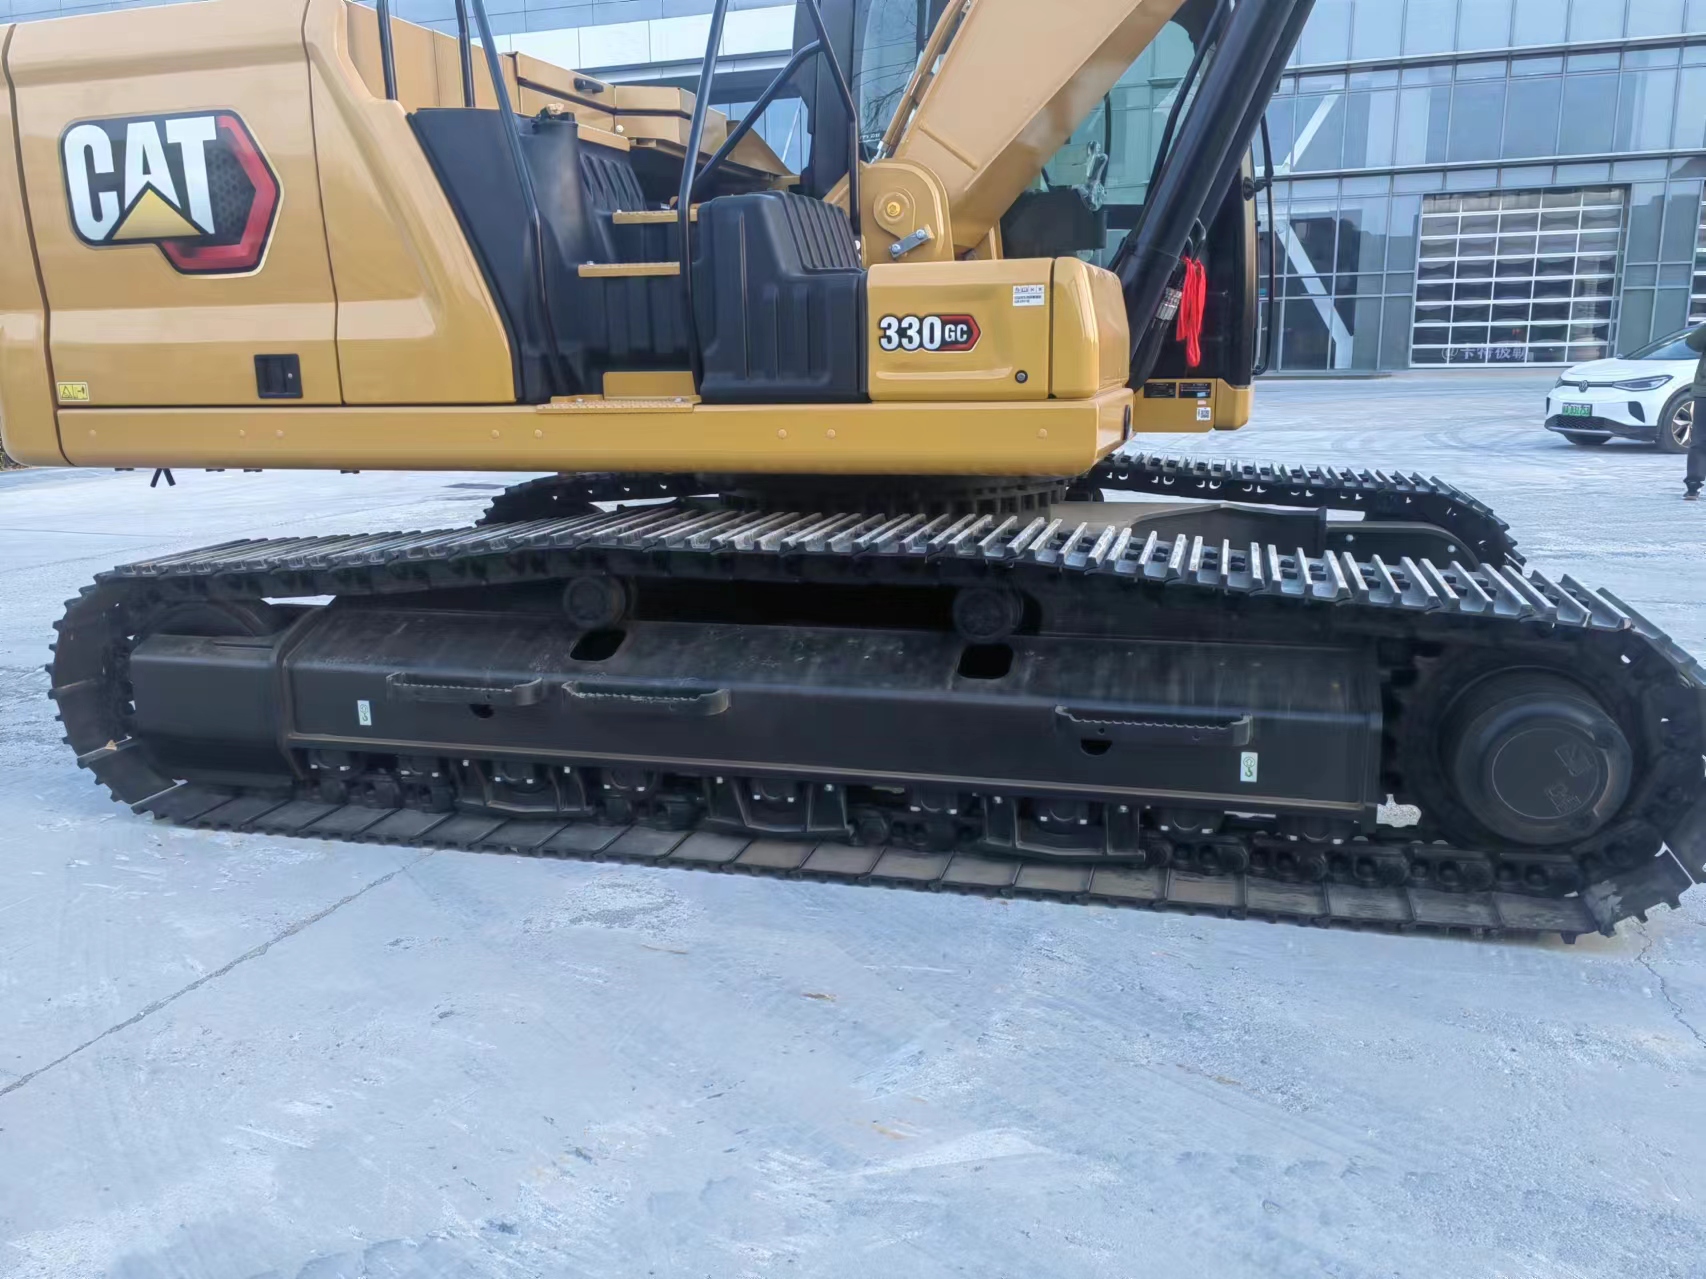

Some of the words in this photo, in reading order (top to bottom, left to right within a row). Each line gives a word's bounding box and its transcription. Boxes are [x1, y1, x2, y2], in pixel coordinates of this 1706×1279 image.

[64, 116, 217, 241] CAT
[880, 316, 942, 350] 330
[944, 323, 968, 342] GC
